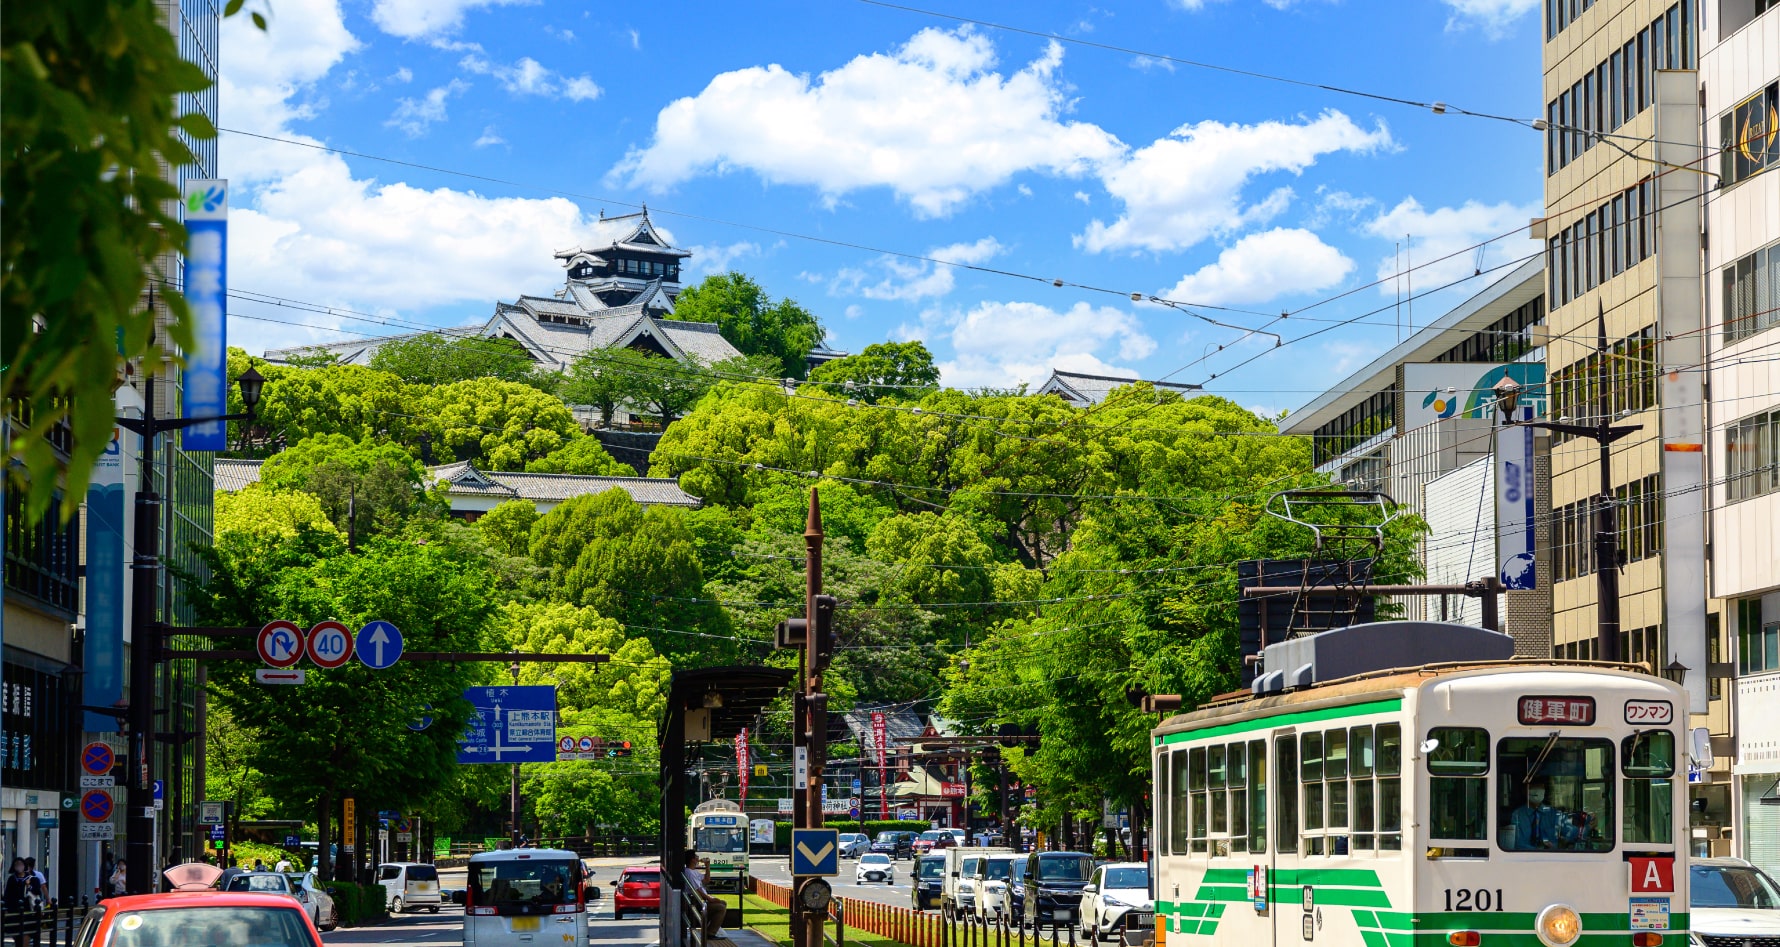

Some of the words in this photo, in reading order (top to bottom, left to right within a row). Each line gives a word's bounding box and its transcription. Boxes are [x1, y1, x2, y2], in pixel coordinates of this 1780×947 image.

[318, 634, 343, 655] 40
[486, 688, 509, 698] 植木
[511, 711, 550, 721] 上熊本駅
[1523, 699, 1590, 722] 健軍町
[1627, 705, 1669, 719] ワンマン
[82, 778, 113, 786] ここまで
[1643, 860, 1662, 889] A
[1444, 888, 1504, 912] 1201
